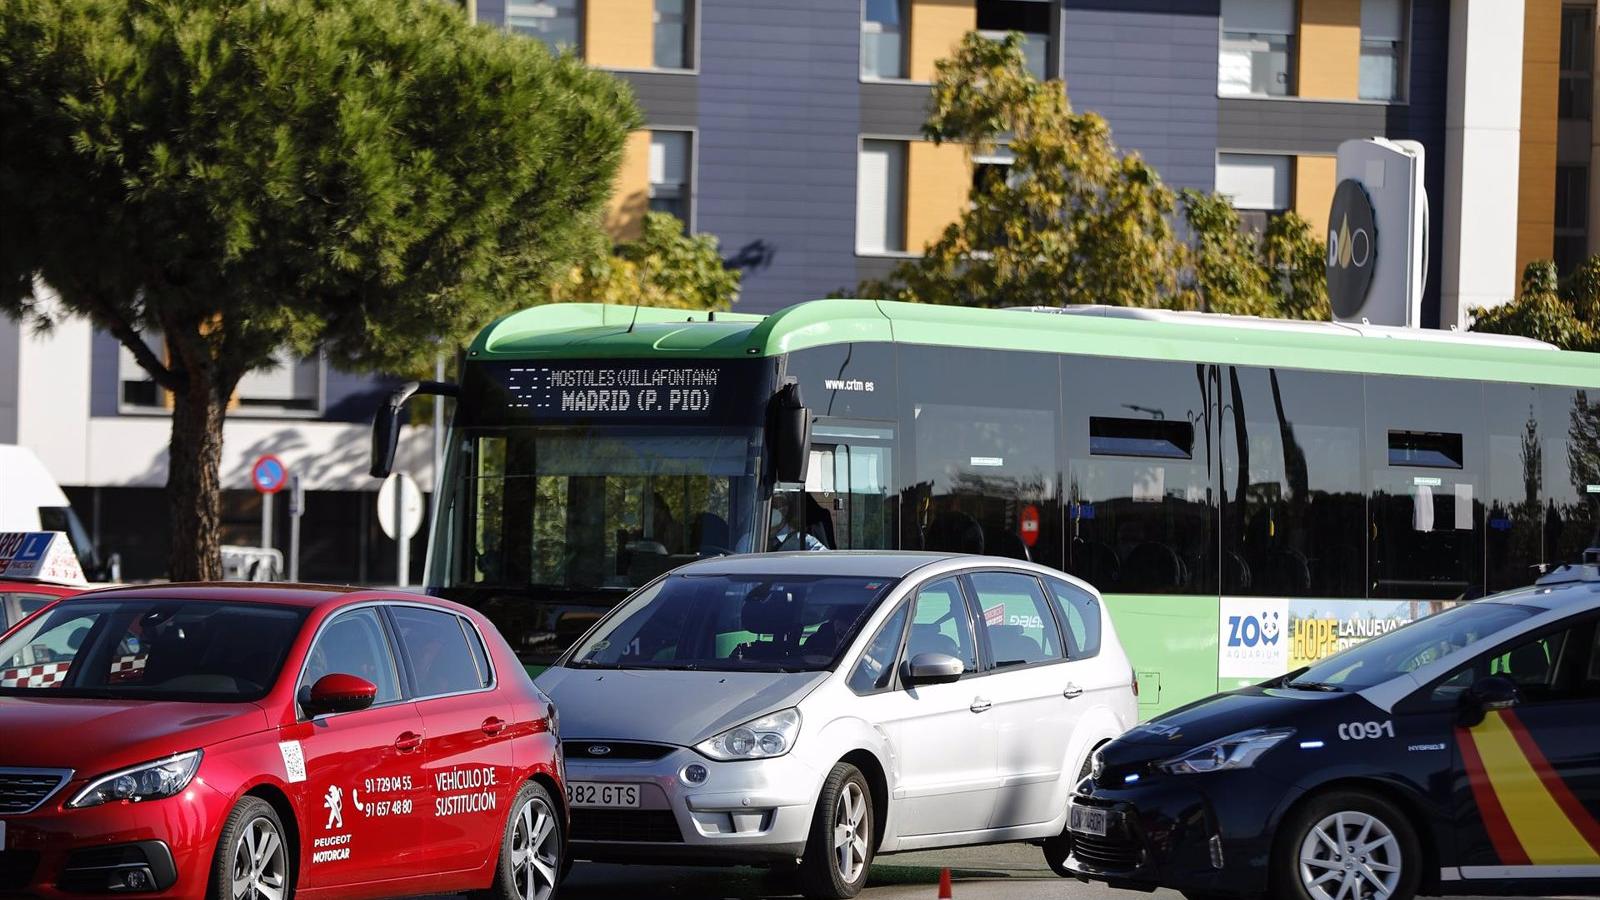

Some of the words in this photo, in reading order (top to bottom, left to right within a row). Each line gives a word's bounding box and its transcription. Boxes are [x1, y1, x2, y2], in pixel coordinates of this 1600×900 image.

[561, 389, 630, 411] MADRID
[637, 389, 662, 411] (P.
[669, 388, 710, 411] PIO)
[1294, 618, 1337, 660] HOPE
[1339, 619, 1355, 636] LA
[365, 778, 375, 793] 91
[376, 777, 390, 792] 729
[391, 776, 401, 791] 04
[402, 775, 412, 790] 55
[435, 766, 481, 791] VEHÍCULO
[483, 767, 495, 786] DE
[435, 787, 495, 816] SUSTITUCIÓN
[602, 786, 635, 805] GTS
[365, 802, 375, 817] 91
[376, 801, 390, 816] 657
[402, 799, 412, 814] 80
[314, 834, 352, 847] PEUGEOT
[312, 847, 350, 864] MOTORCAR
